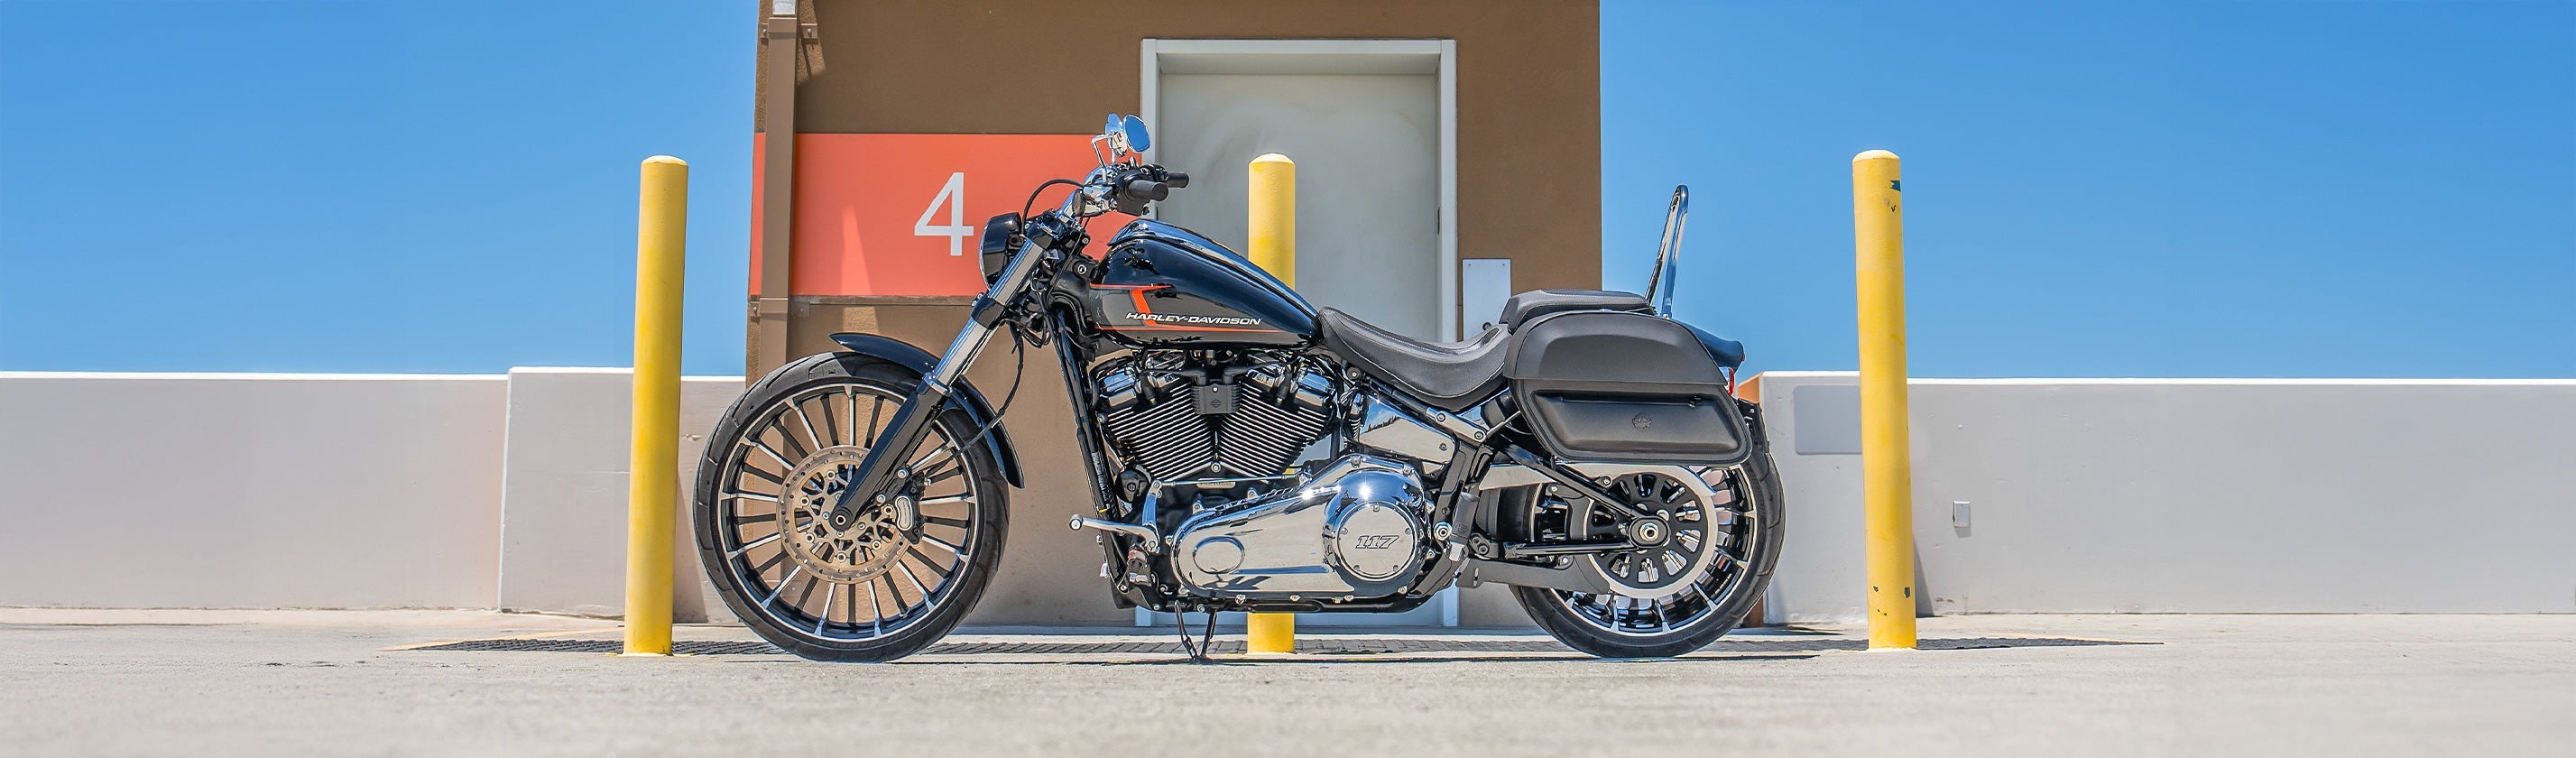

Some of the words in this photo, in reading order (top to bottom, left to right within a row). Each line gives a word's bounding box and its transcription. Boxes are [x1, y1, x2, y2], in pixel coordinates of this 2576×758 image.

[914, 172, 974, 256] 4
[1125, 312, 1261, 326] HARLEY-DAVIDSON
[1355, 535, 1399, 549] 117
